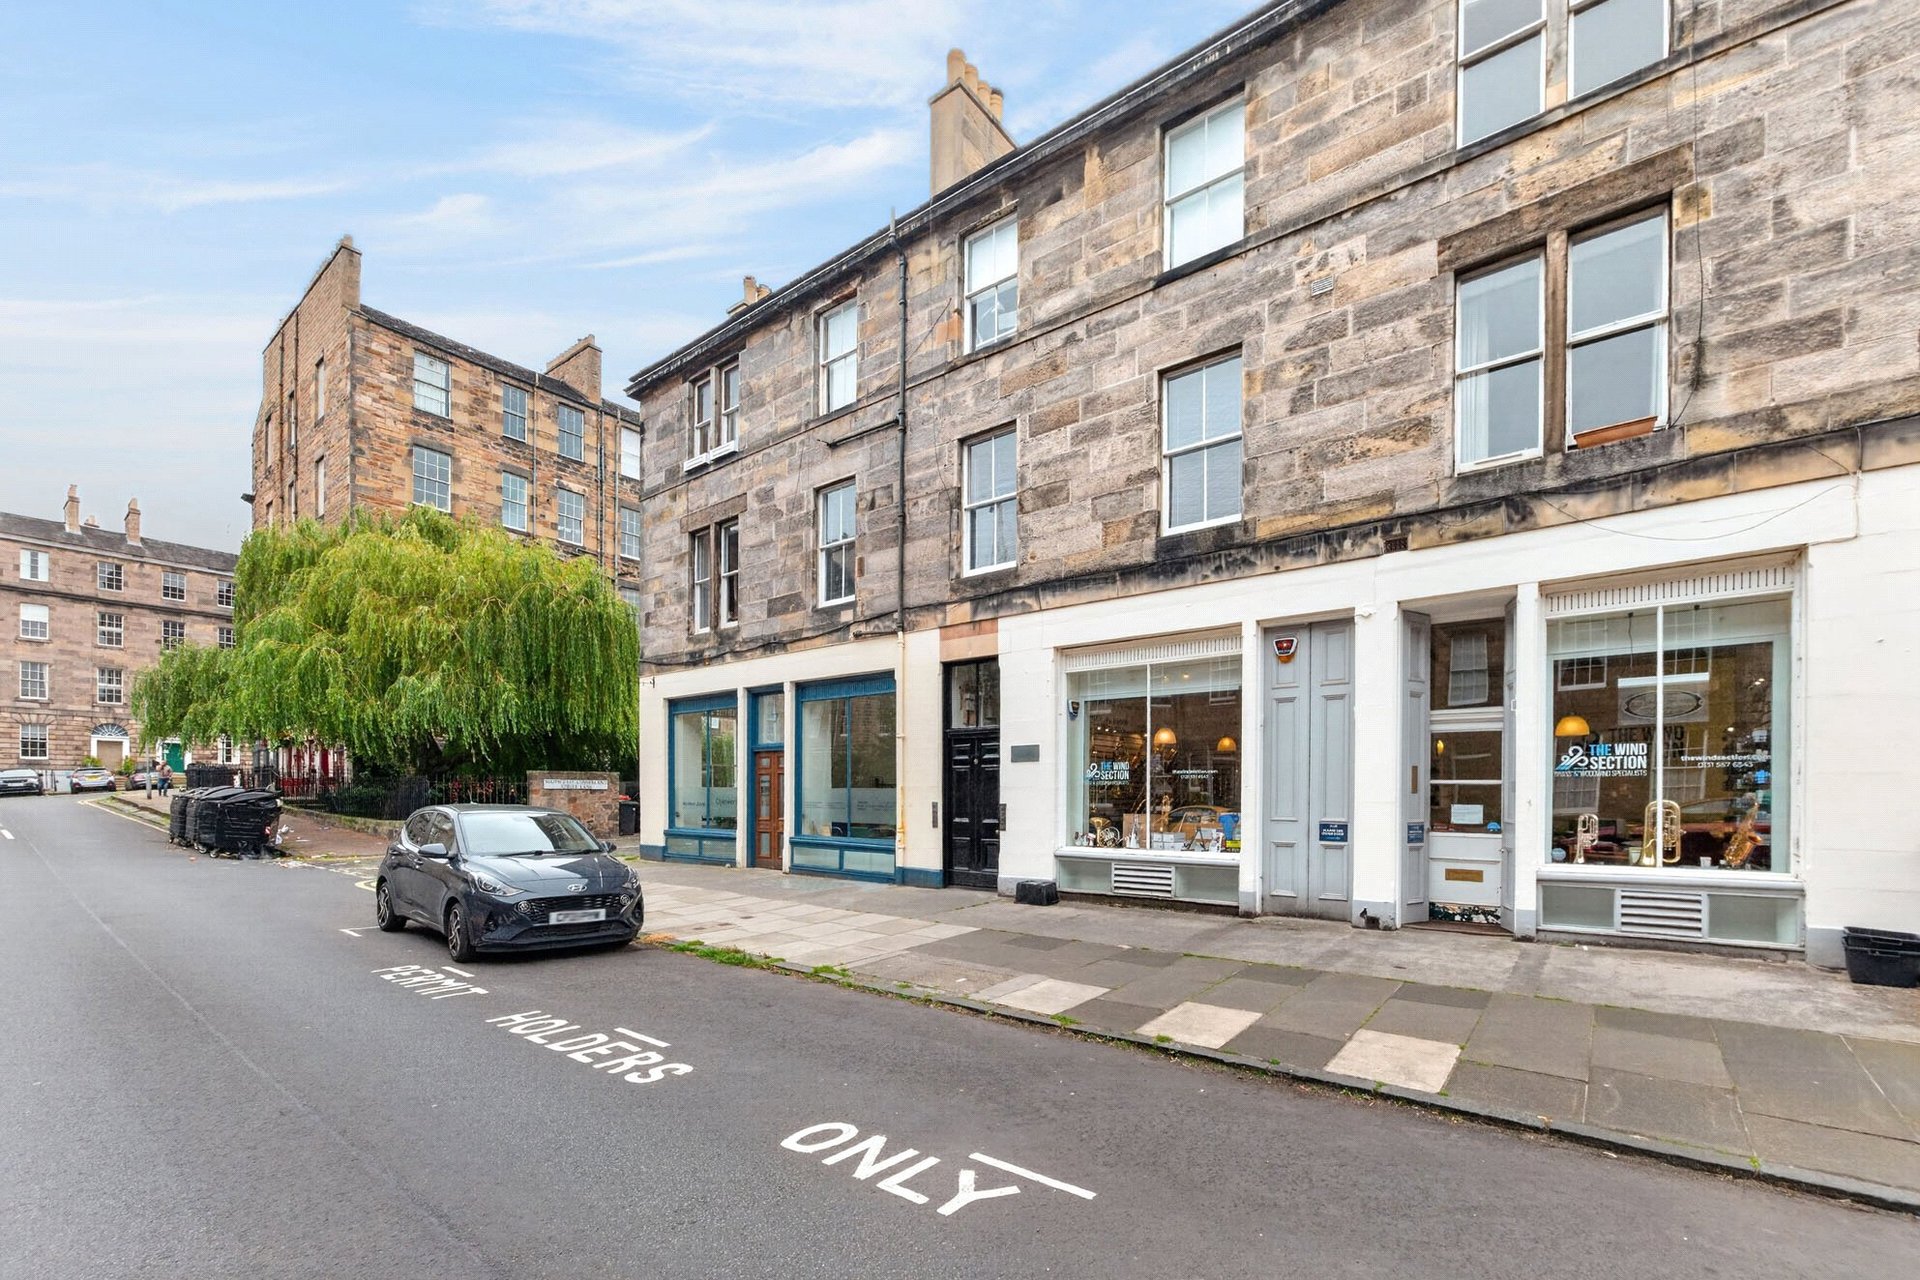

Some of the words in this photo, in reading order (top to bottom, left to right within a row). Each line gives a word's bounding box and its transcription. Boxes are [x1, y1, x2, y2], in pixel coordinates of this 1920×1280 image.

[1589, 743, 1612, 756] THE
[1614, 742, 1648, 756] WIND
[1113, 761, 1130, 770] WIND
[1589, 756, 1647, 770] SECTION
[1100, 770, 1130, 780] SECTION
[1611, 769, 1648, 777] SPECIALISTS
[370, 965, 489, 1000] PERMIT
[485, 1010, 694, 1083] HOLDERS
[780, 1122, 1021, 1216] ONLY
